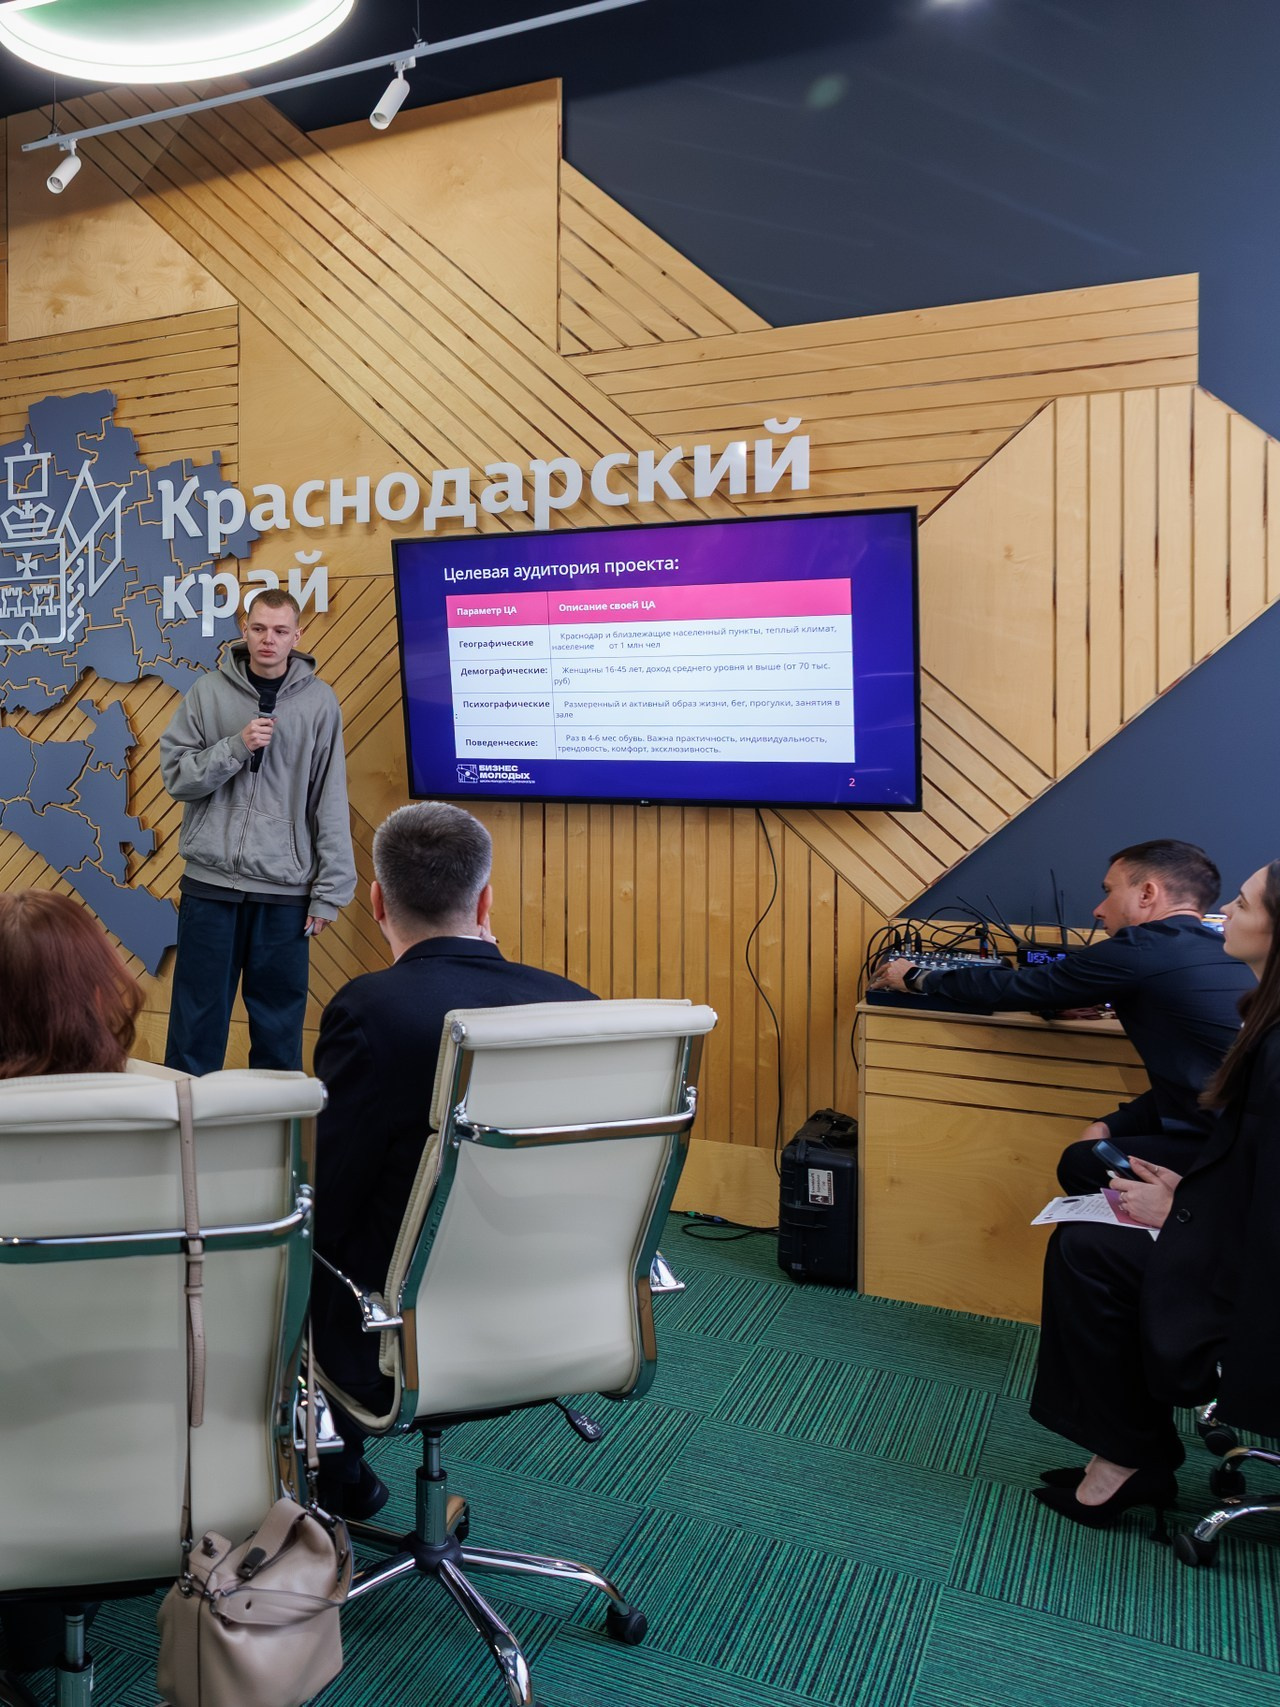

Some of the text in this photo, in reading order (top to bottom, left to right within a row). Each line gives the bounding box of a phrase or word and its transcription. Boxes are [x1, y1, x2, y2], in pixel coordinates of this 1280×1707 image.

[157, 417, 811, 553] Краснодарский
[444, 558, 680, 583] Целевая аудитория проекта:
[161, 550, 330, 637] край
[456, 605, 518, 619] Параметр ЦА
[558, 600, 656, 615] Описание своей ЦА
[560, 631, 604, 642] Краснодар
[612, 629, 671, 640] близлежащие
[673, 627, 726, 638] населенный
[728, 626, 764, 637] пункты,
[766, 625, 800, 635] теплый
[801, 625, 837, 635] климат,
[458, 639, 535, 651] Географические
[552, 641, 661, 651] население от 1 млн чел
[460, 666, 548, 678] Демографические:
[561, 661, 831, 675] Женщины 16-45 лет, доход среднего уровня и выше (от 70 тыс.
[553, 677, 571, 686] руб)
[462, 700, 550, 712] Психографические
[564, 700, 620, 710] Размеренный
[629, 699, 670, 708] активный
[672, 700, 697, 710] образ
[699, 700, 729, 709] жизни,
[731, 699, 747, 709] бег,
[750, 699, 793, 710] прогулки,
[795, 699, 833, 708] занятия
[835, 699, 841, 707] в
[465, 738, 539, 749] Поведенческие:
[566, 734, 580, 743] Раз
[588, 734, 600, 743] 4-6
[602, 735, 617, 743] мес
[618, 733, 645, 744] обувь.
[647, 734, 674, 743] Важна
[675, 735, 738, 745] практичность,
[739, 735, 827, 744] индивидуальность,
[557, 745, 610, 755] трендовость,
[611, 745, 649, 756] комфорт,
[478, 764, 519, 772] БИЗНЕС
[479, 771, 531, 781] МОЛОДЫХ
[848, 777, 856, 788] 2
